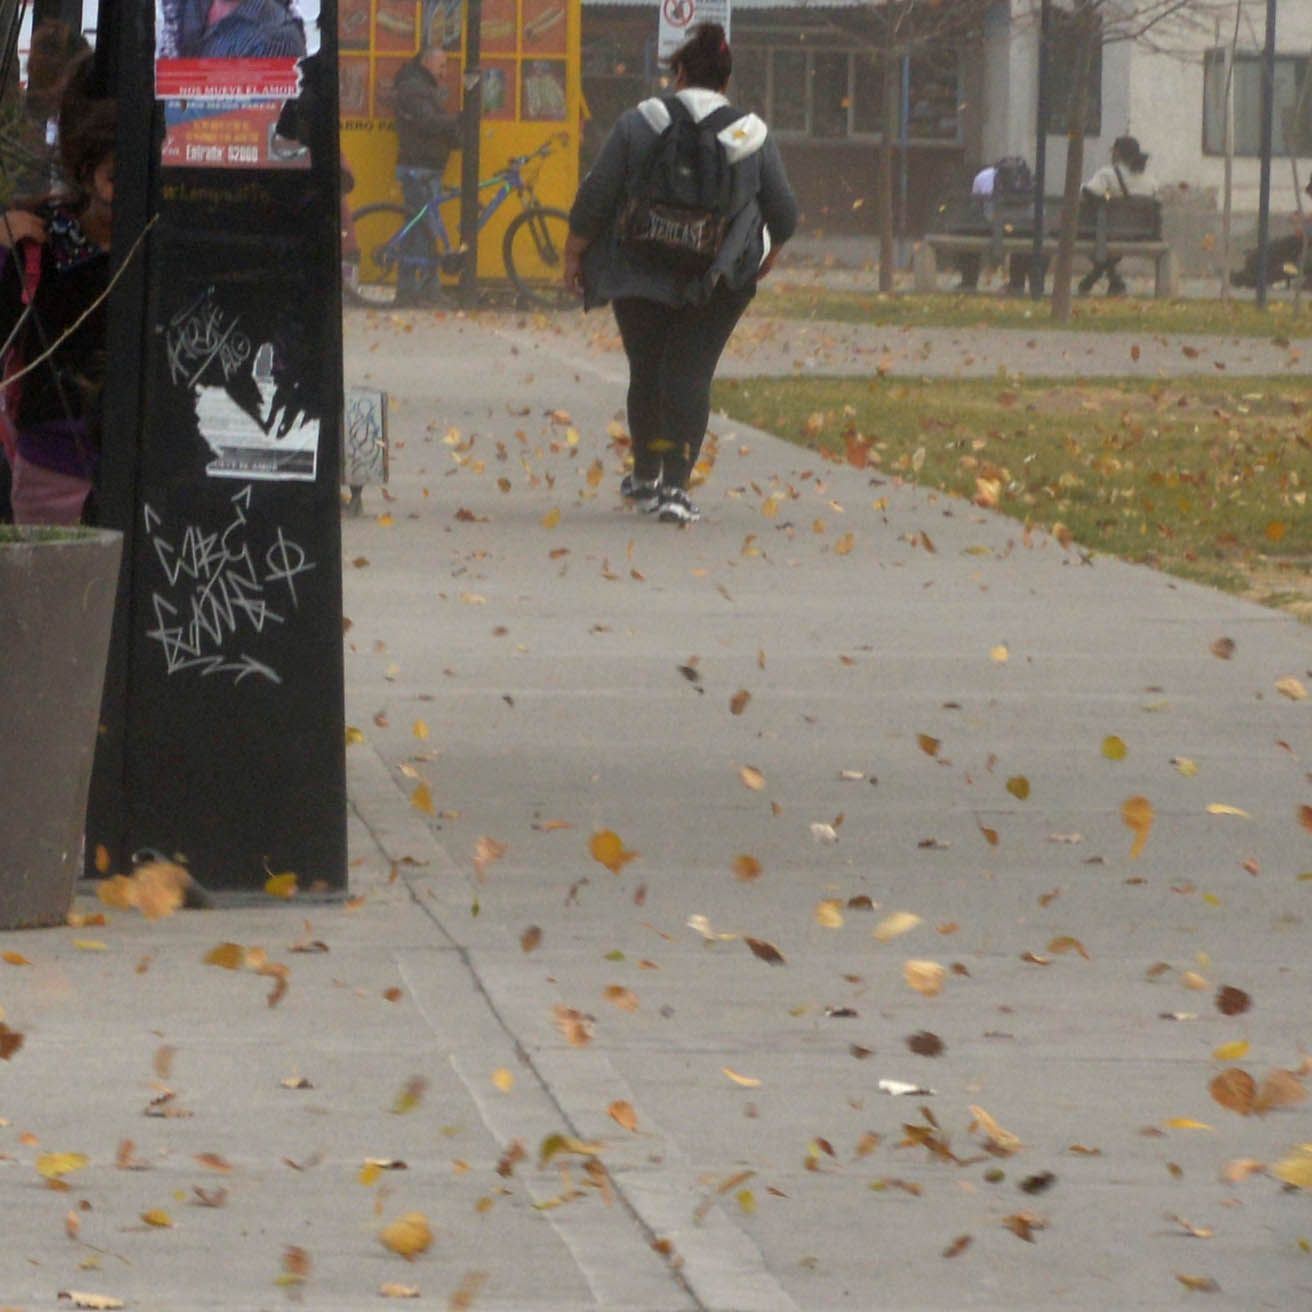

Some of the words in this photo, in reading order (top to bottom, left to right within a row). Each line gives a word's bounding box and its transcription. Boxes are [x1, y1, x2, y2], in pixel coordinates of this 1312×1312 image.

[204, 85, 240, 96] MUEVE
[245, 85, 256, 96] EL
[262, 85, 296, 96] AMOR
